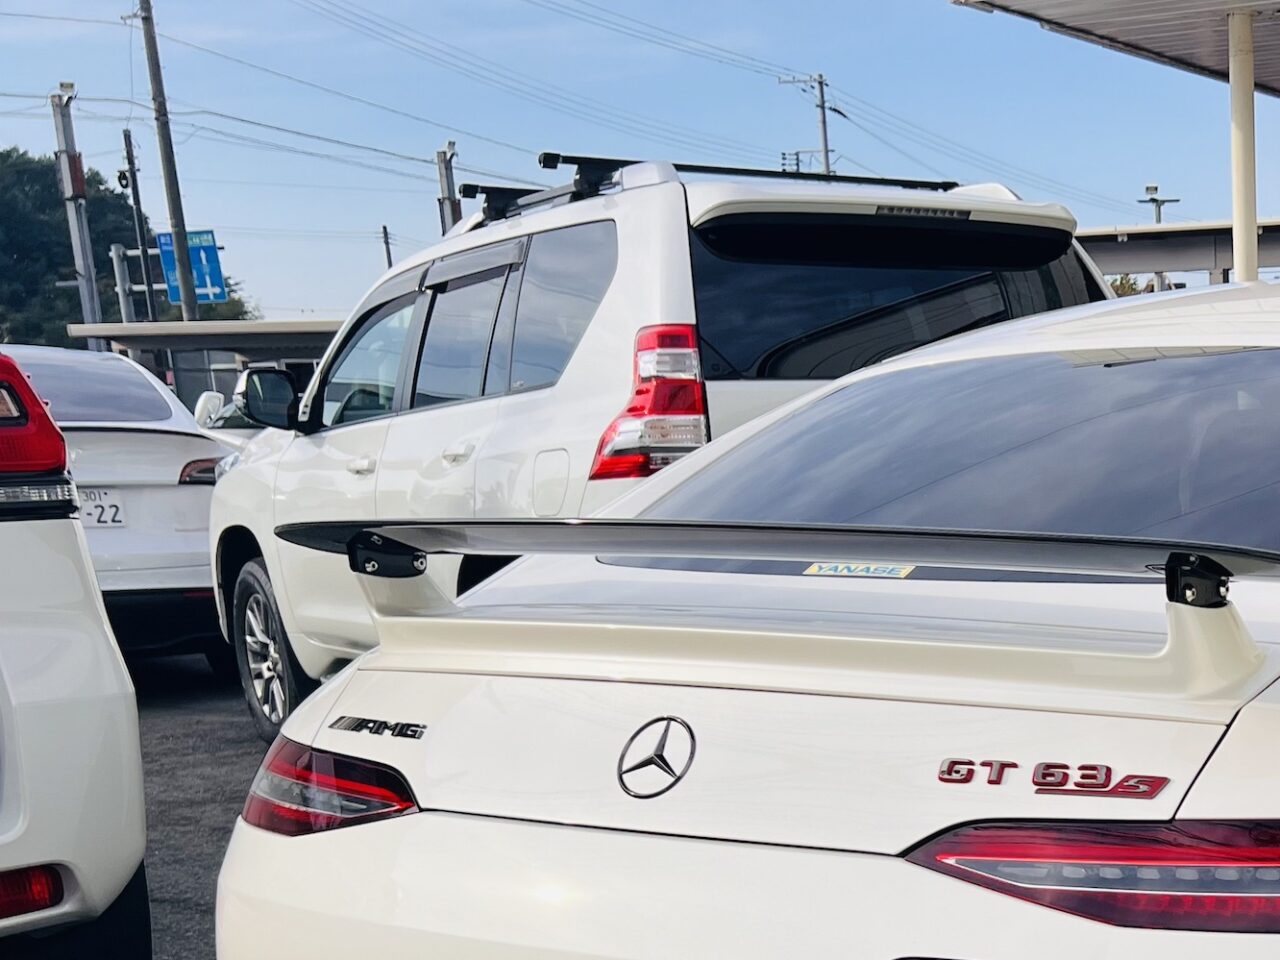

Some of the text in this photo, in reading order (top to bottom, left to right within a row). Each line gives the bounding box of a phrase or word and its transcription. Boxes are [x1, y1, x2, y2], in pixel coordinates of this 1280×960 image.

[815, 564, 906, 576] YANASE
[349, 717, 427, 740] AMG
[938, 757, 1019, 785] GT
